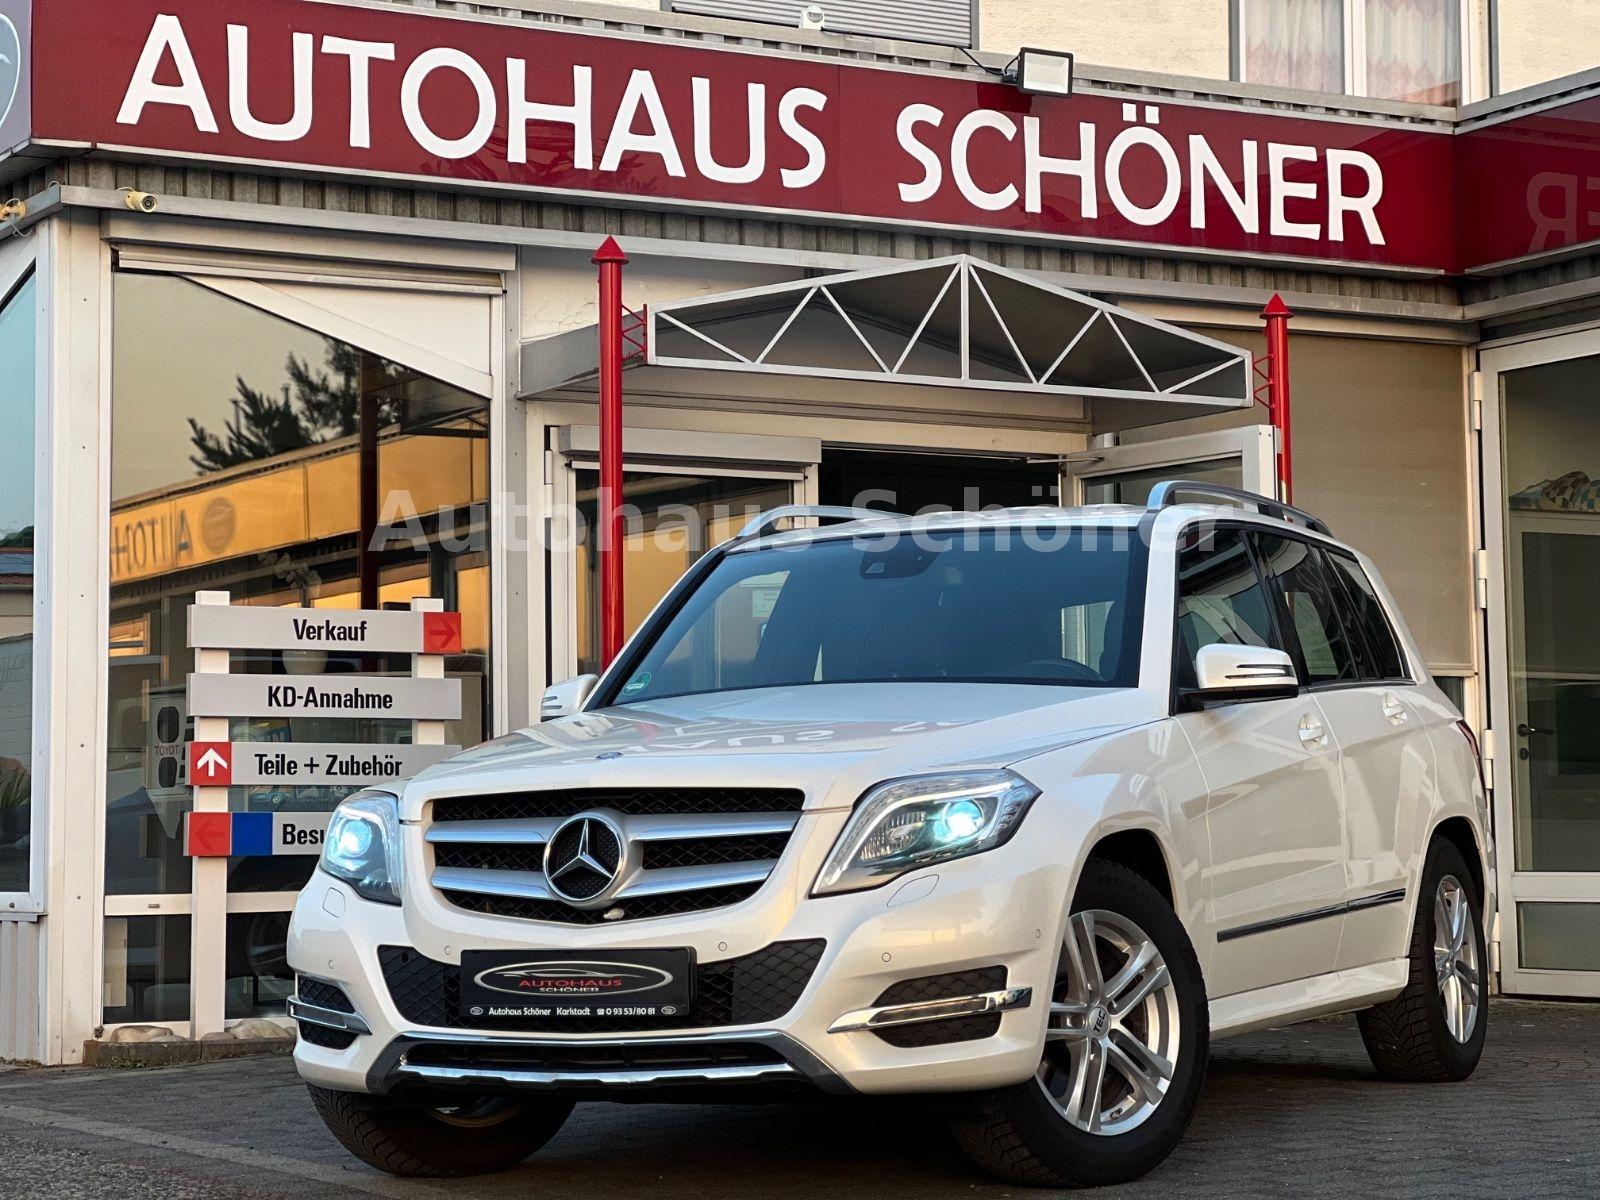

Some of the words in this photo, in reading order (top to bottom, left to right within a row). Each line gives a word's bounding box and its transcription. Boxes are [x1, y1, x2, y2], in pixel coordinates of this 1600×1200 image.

[115, 13, 828, 189] AUTOHAUS
[896, 102, 1386, 246] SCHÖNER
[292, 618, 368, 643] Verkauf
[267, 685, 393, 710] KD-Annahme
[254, 753, 298, 776] Teile
[303, 756, 320, 775] +
[325, 754, 403, 777] Zubehör
[519, 979, 622, 988] AUTOHAUS
[488, 1006, 522, 1016] Autohaus
[523, 1006, 552, 1016] Schöner
[556, 1006, 591, 1016] Karlstadt
[1093, 1009, 1106, 1032] TEC
